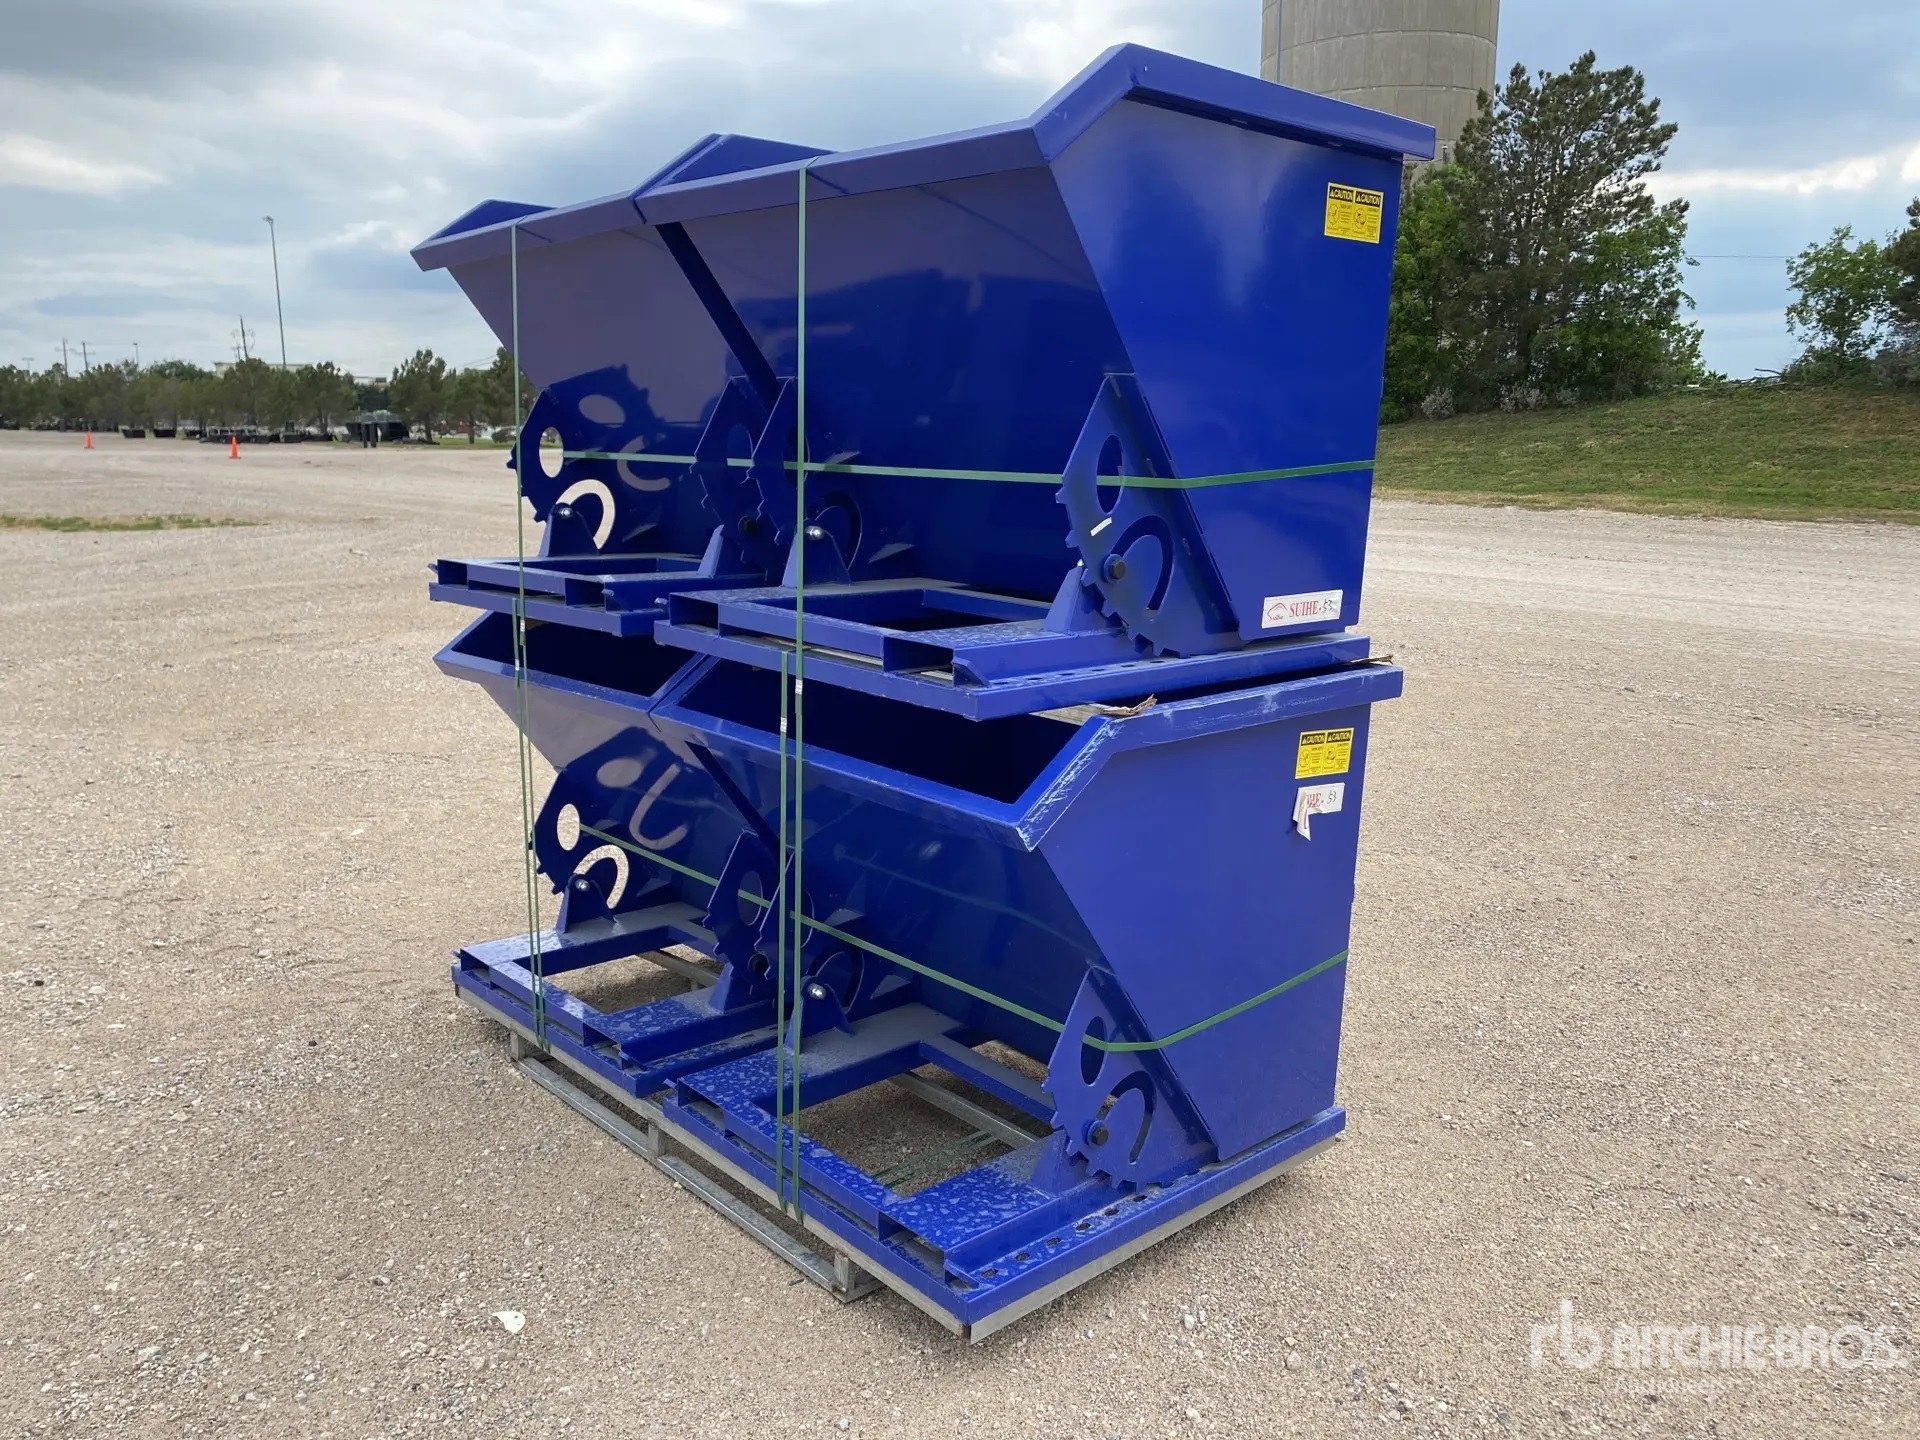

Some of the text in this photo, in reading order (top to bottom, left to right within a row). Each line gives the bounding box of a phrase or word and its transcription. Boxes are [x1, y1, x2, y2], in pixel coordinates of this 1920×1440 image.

[1334, 189, 1353, 202] CAUTION
[1361, 193, 1380, 206] CAUTION
[1289, 600, 1319, 618] SUIHE
[1306, 734, 1325, 744] CAUTION
[1332, 731, 1351, 742] CAUTION
